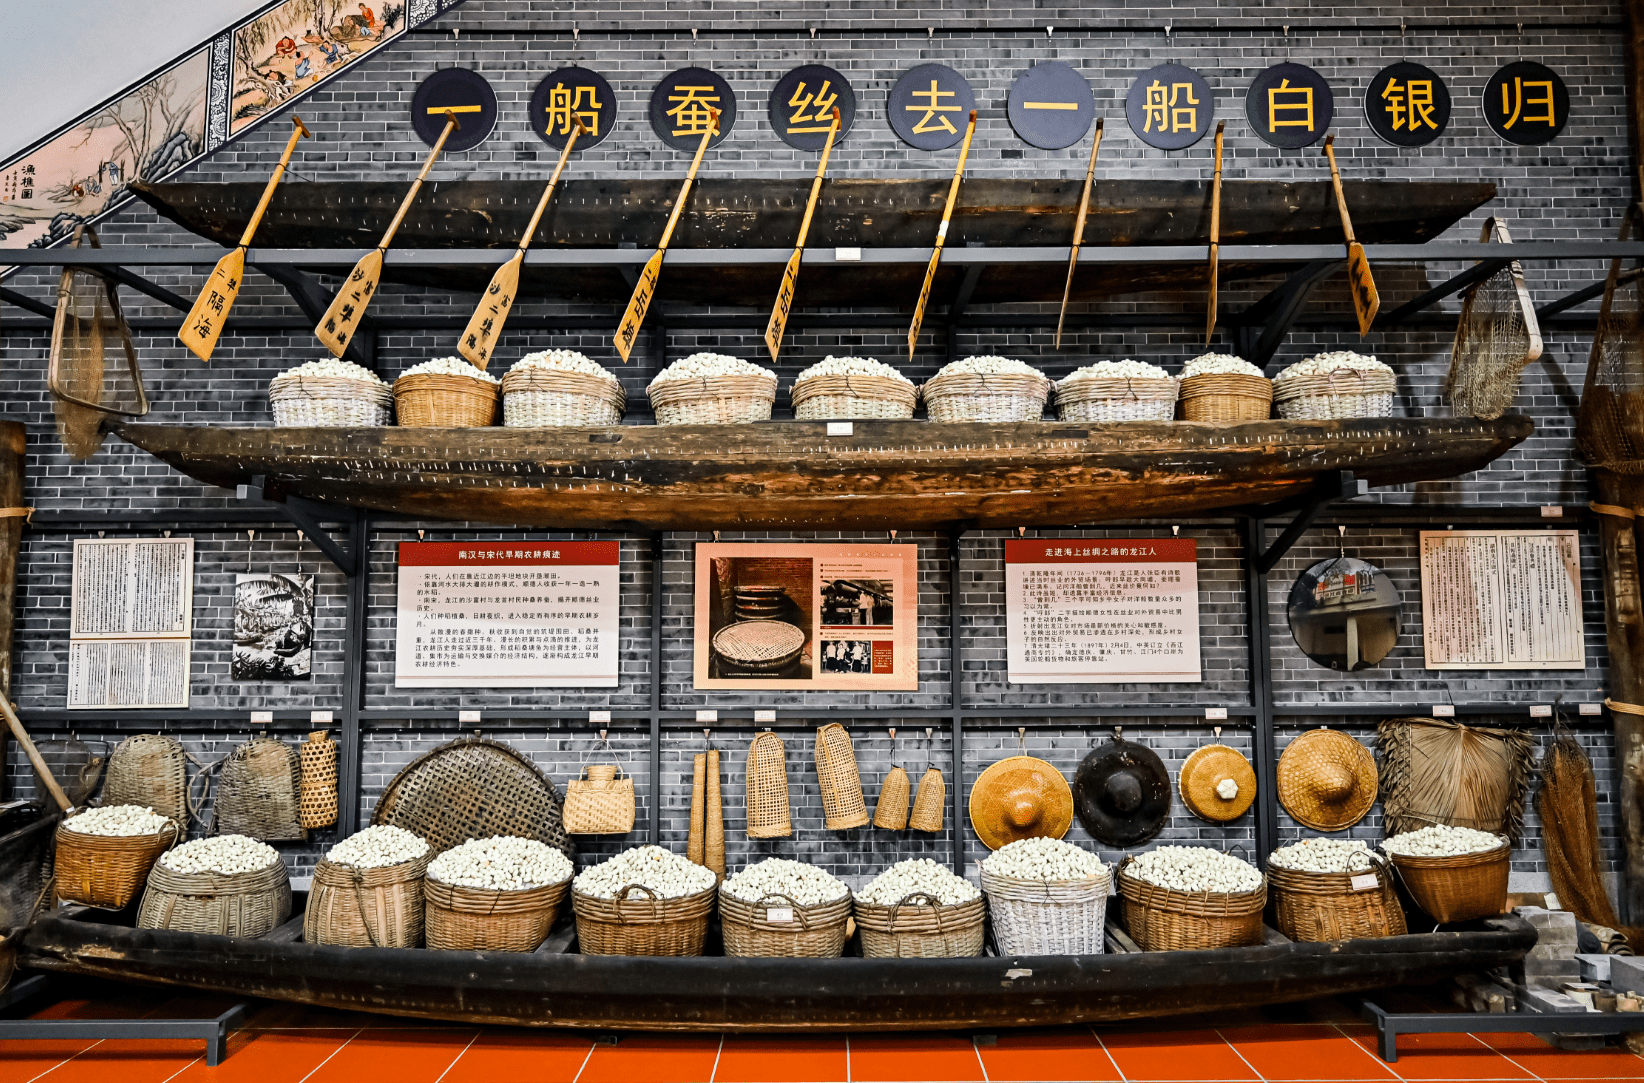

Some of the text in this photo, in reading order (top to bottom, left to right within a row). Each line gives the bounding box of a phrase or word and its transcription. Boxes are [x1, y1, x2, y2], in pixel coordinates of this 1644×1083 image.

[20, 164, 36, 199] 漁樵圖
[1045, 548, 1157, 556] 走进海上丝绸之路的龙江人
